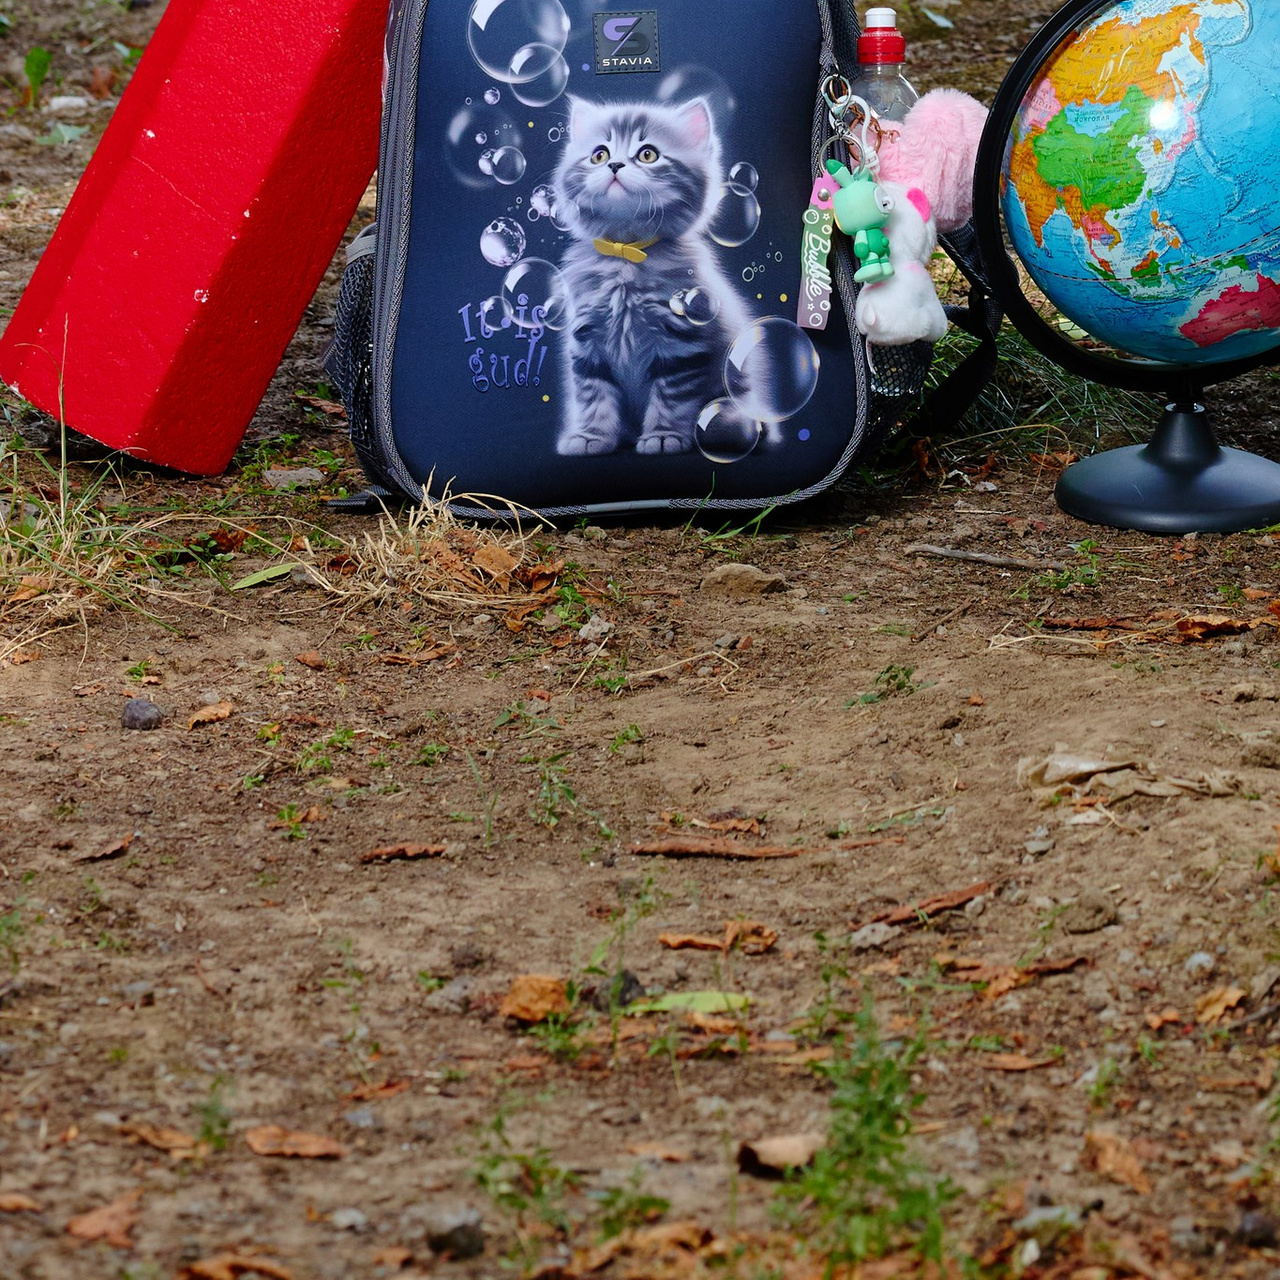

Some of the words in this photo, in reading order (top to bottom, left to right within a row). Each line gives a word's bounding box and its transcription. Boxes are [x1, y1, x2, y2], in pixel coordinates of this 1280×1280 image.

[602, 57, 653, 67] STAVIA
[808, 231, 833, 298] Bubble
[458, 301, 495, 343] It
[515, 293, 548, 341] is
[469, 339, 548, 392] gud!
